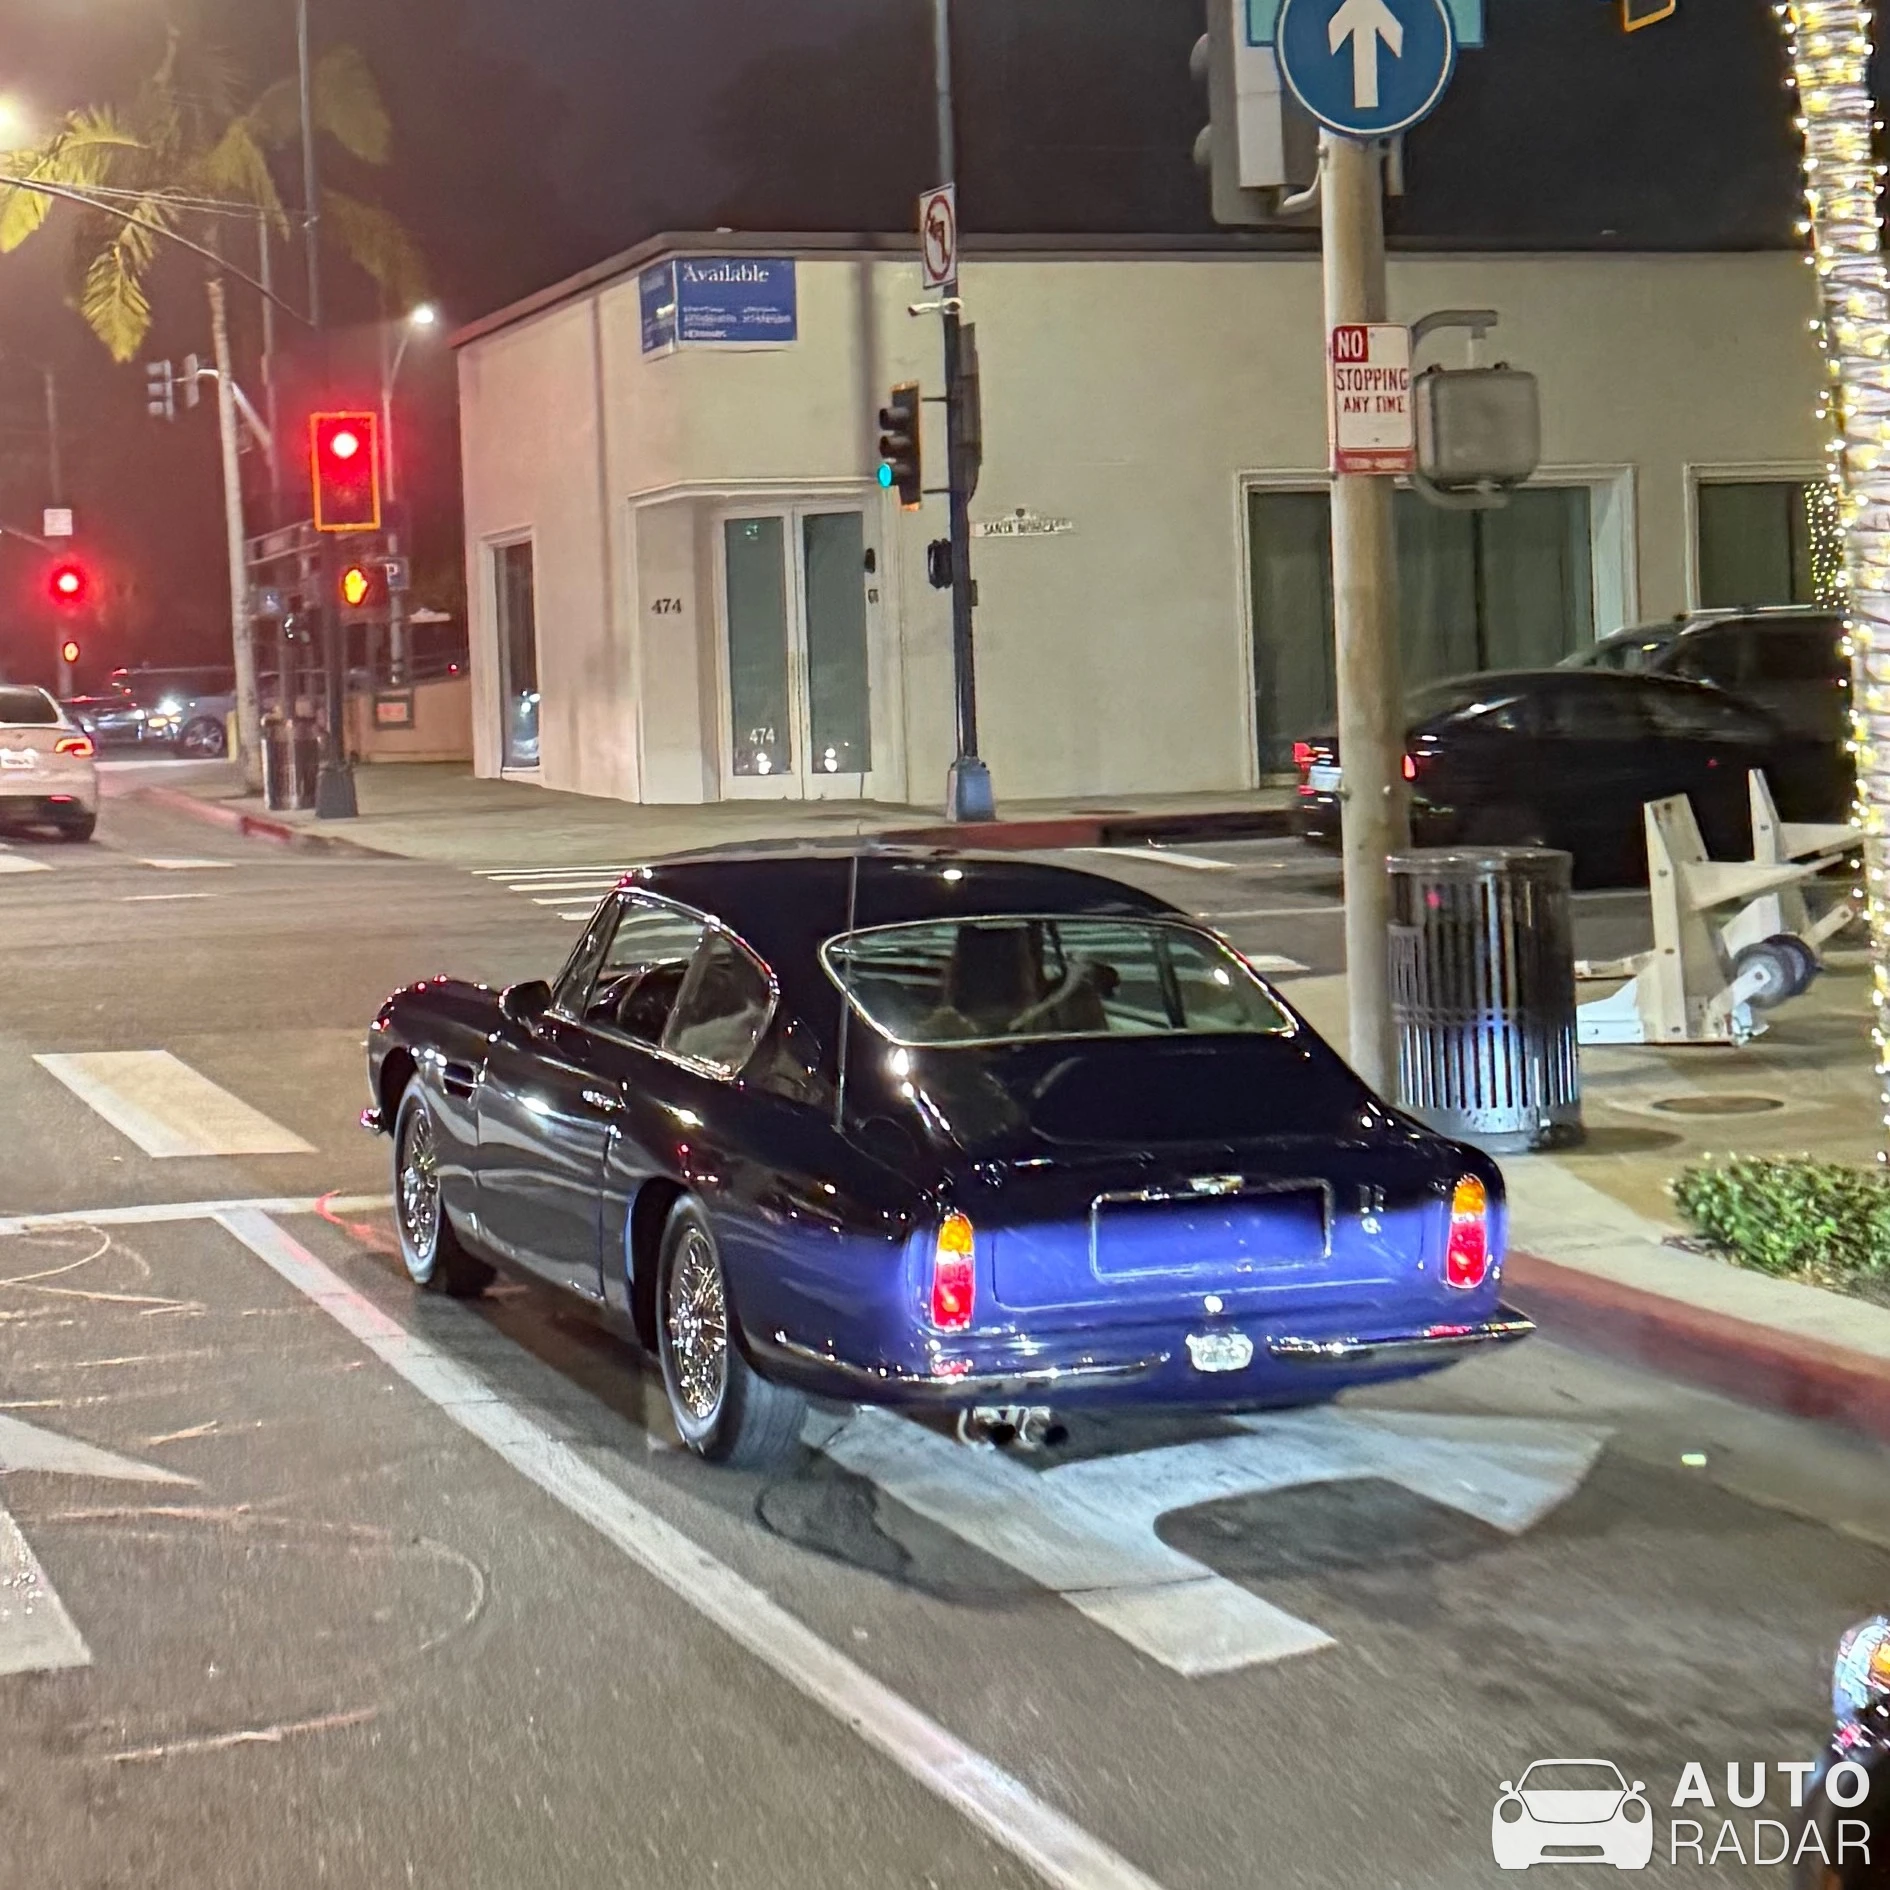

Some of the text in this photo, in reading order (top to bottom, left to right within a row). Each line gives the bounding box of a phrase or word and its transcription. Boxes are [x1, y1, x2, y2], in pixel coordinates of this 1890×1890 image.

[683, 264, 769, 283] Available
[1337, 331, 1363, 358] NO
[1336, 368, 1409, 391] STOPPING
[1344, 396, 1406, 413] ANY TIME
[651, 598, 682, 614] 474
[749, 728, 775, 744] 474
